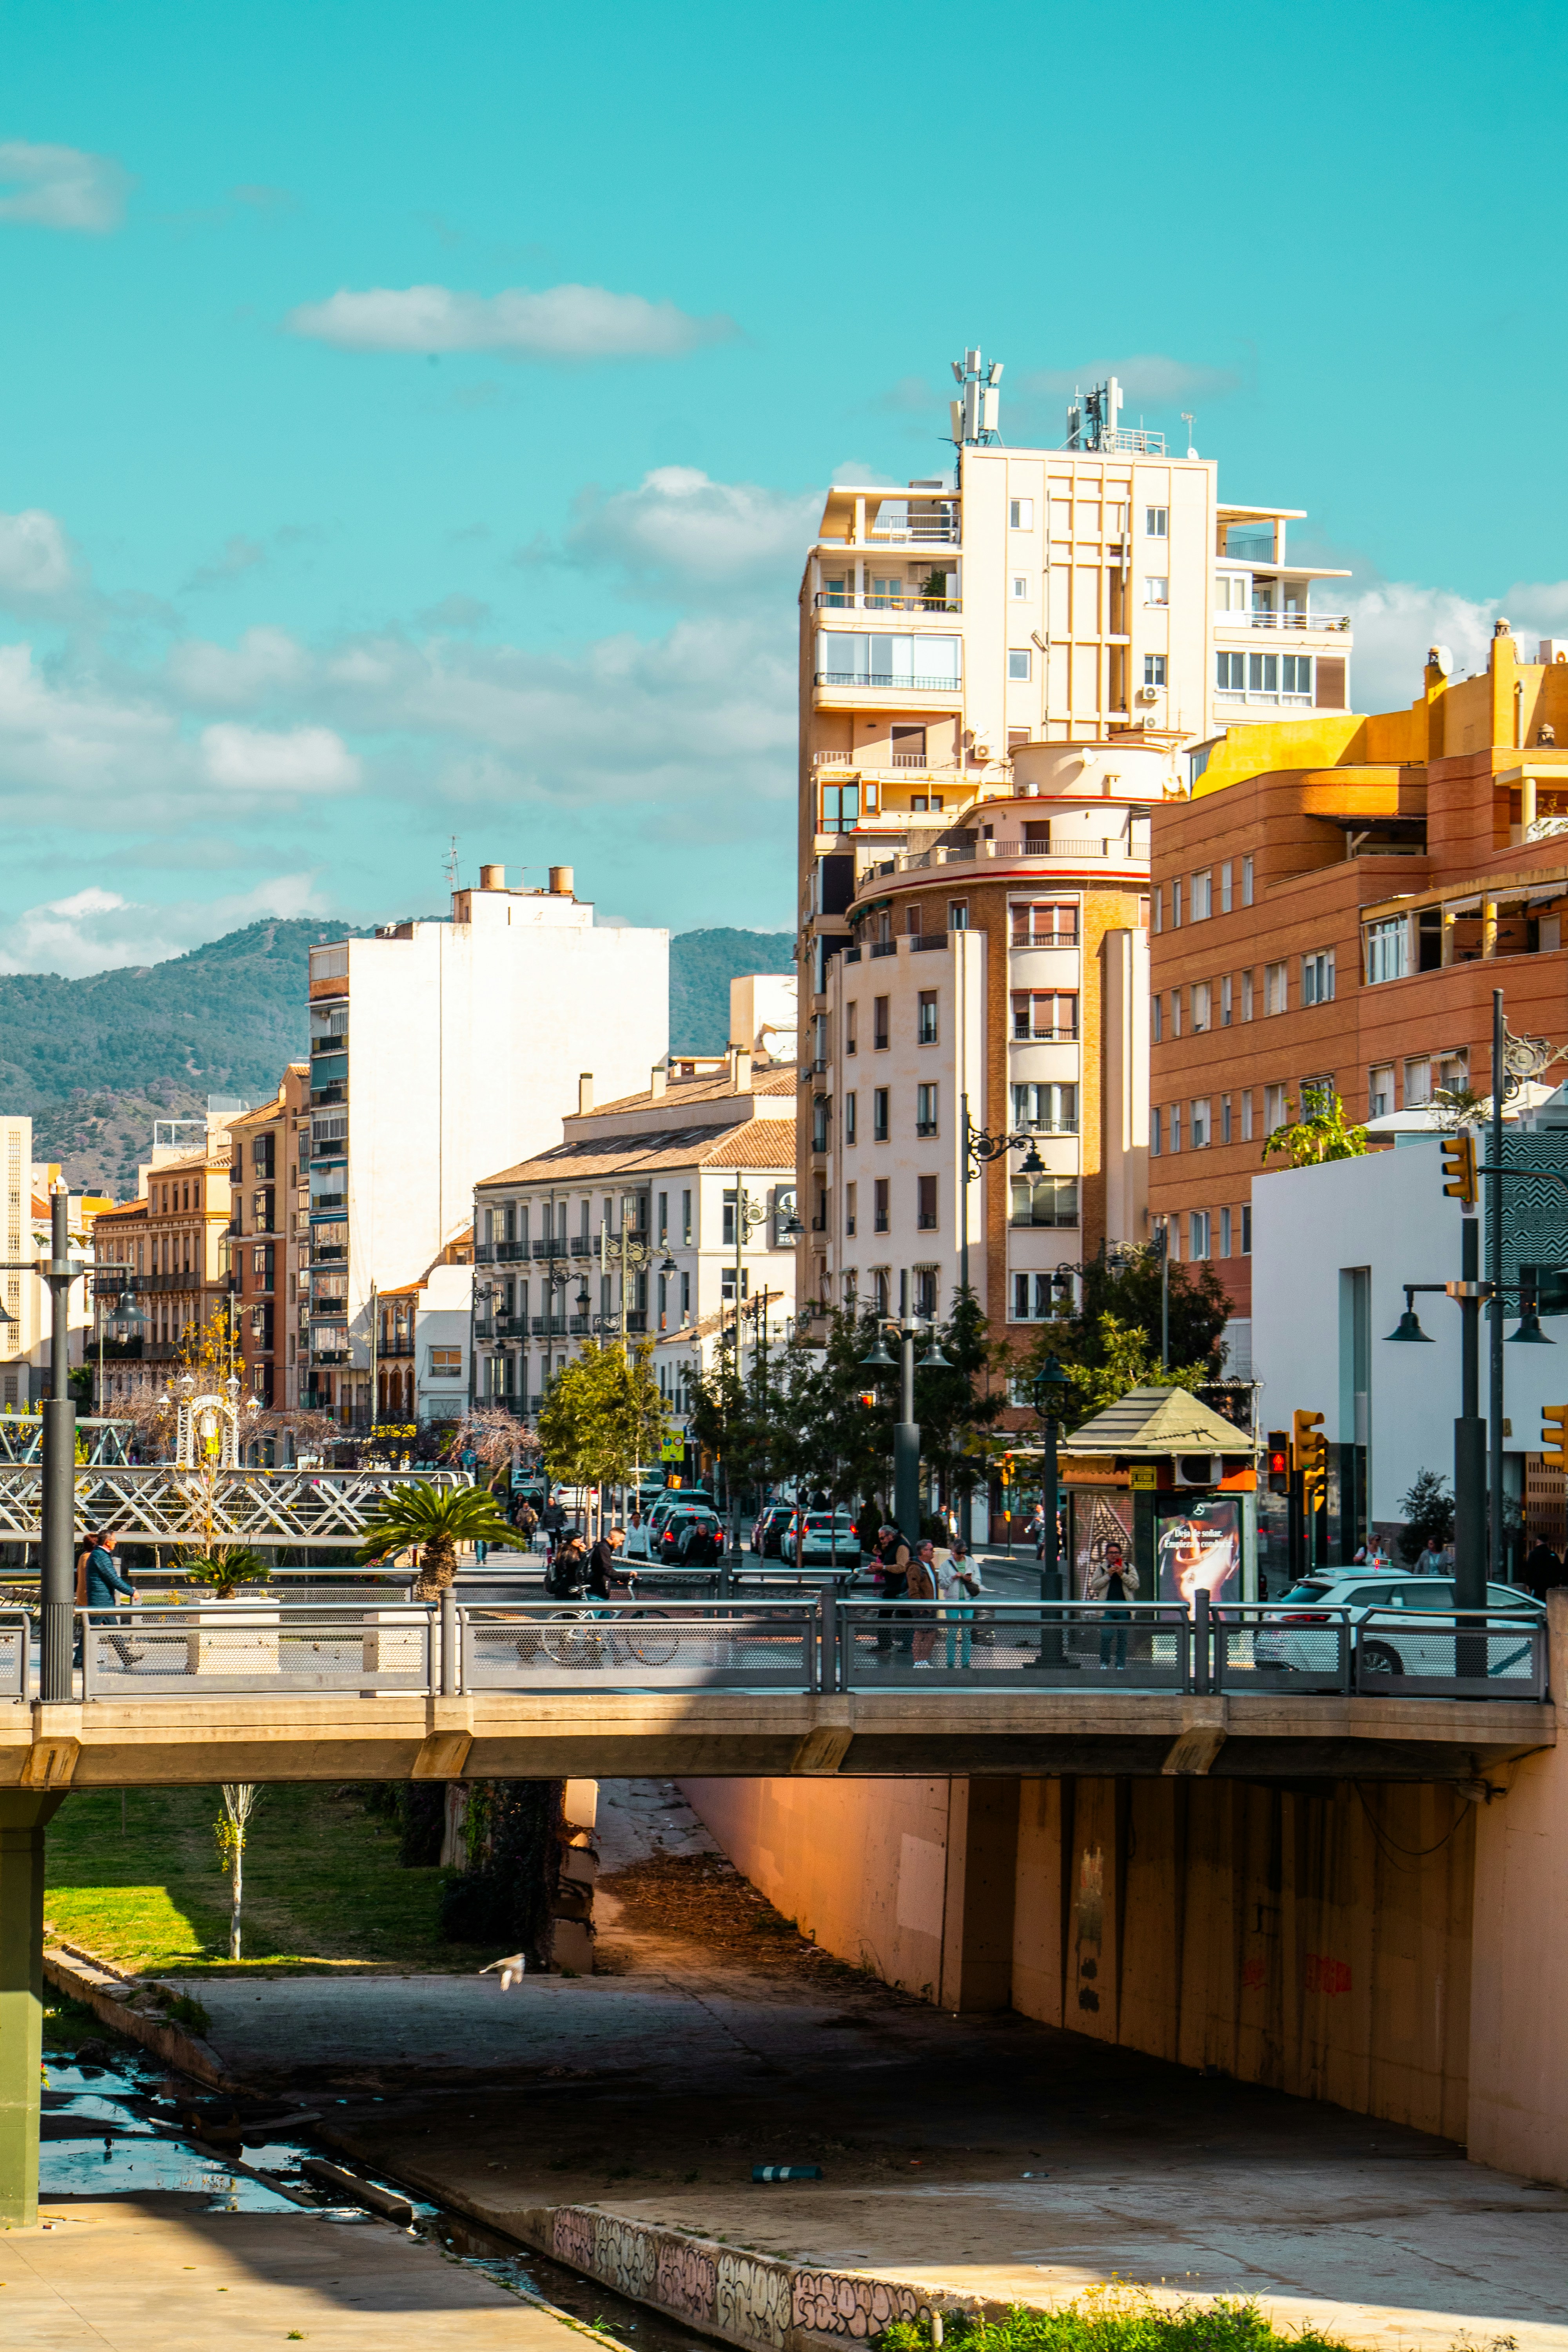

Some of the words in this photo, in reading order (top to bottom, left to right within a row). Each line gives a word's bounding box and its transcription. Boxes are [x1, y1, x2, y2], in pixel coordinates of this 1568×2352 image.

[1174, 1529, 1191, 1539] Deja
[1193, 1529, 1201, 1537] de
[1201, 1529, 1223, 1537] soñar.
[1164, 1539, 1194, 1549] Empieza
[1200, 1539, 1234, 1548] conducir.
